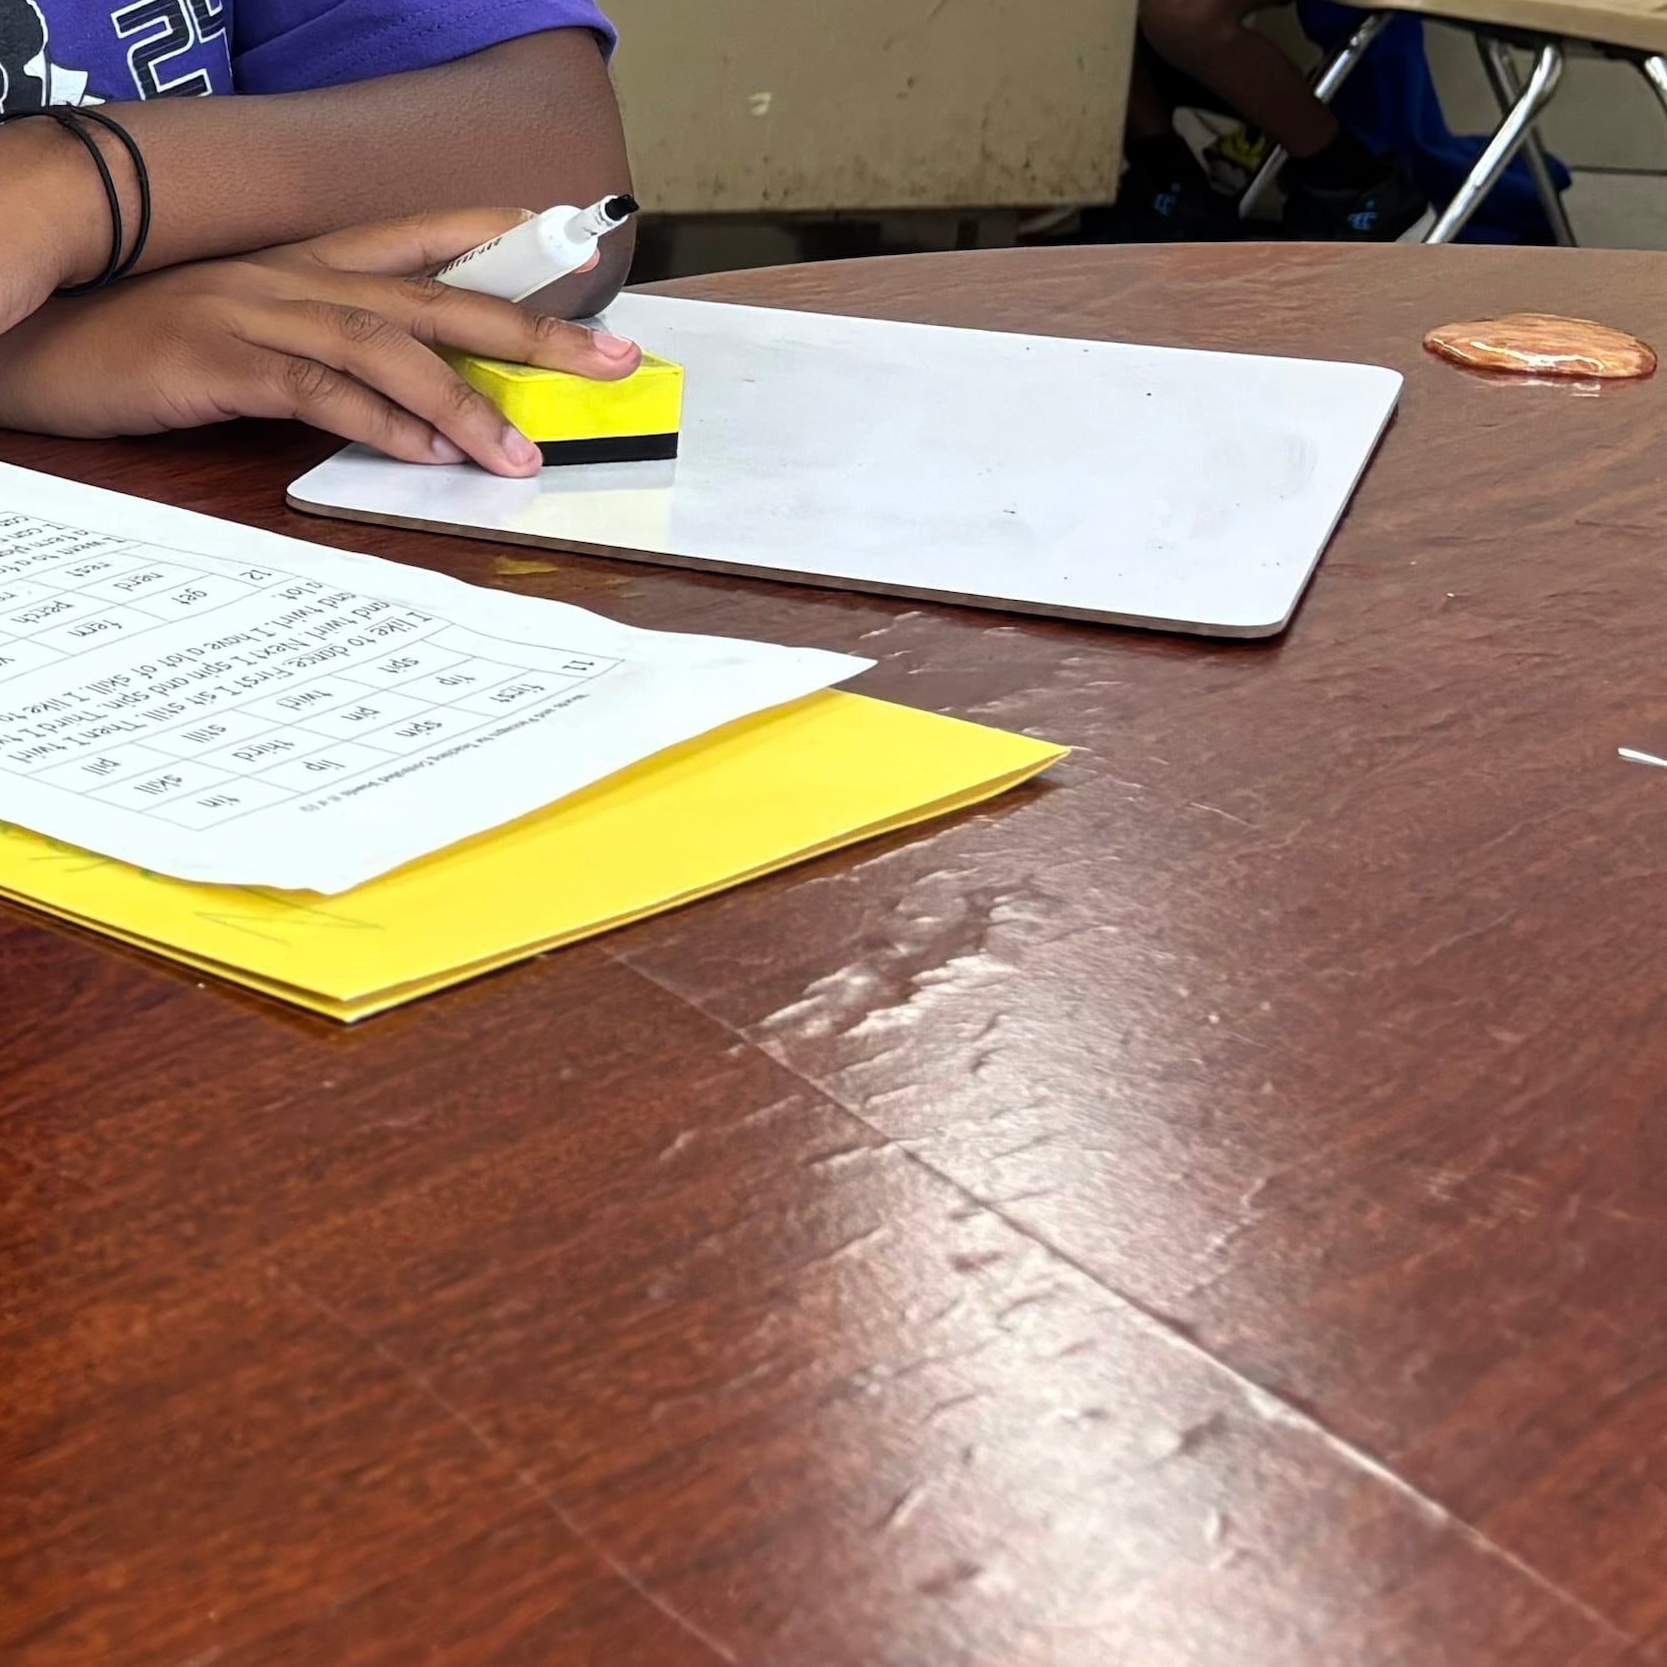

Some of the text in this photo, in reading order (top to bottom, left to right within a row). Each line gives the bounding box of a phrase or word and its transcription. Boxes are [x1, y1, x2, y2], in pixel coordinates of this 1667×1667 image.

[6, 527, 43, 539] can
[42, 523, 68, 531] I
[28, 534, 79, 548] fern
[56, 541, 106, 555] went
[65, 562, 111, 577] rest
[239, 569, 272, 581] 12
[112, 572, 164, 592] nerd
[271, 581, 324, 600] a lot.
[171, 588, 208, 605] get
[317, 592, 356, 609] and
[10, 600, 74, 624] perch
[264, 605, 325, 629] twirl.
[350, 601, 390, 620] and
[67, 619, 123, 637] fern
[249, 627, 276, 638] I
[298, 616, 358, 641] twirl.
[203, 633, 262, 650] have
[248, 637, 311, 660] Next
[185, 647, 206, 656] a
[157, 653, 198, 668] lot
[229, 655, 258, 666] I
[377, 657, 420, 674] spit
[562, 660, 595, 671] 11
[130, 665, 158, 680] of
[186, 661, 233, 680] spin
[7, 611, 433, 764] I like to dance. First I sit still. Then I twirl
[78, 674, 131, 695] skill.
[147, 677, 190, 697] and
[435, 674, 476, 686] tip
[62, 691, 91, 703] I
[96, 691, 150, 710] spin.
[277, 690, 333, 711] twirl
[489, 683, 545, 703] first
[22, 698, 72, 714] like
[340, 706, 381, 721] pin
[36, 710, 108, 734] Third
[394, 721, 443, 737] spin
[17, 728, 47, 738] I
[181, 724, 227, 744] still
[231, 739, 295, 763] third
[81, 757, 122, 776] pill
[302, 759, 346, 772] lip
[133, 774, 183, 795] skill
[197, 795, 240, 808] tin
